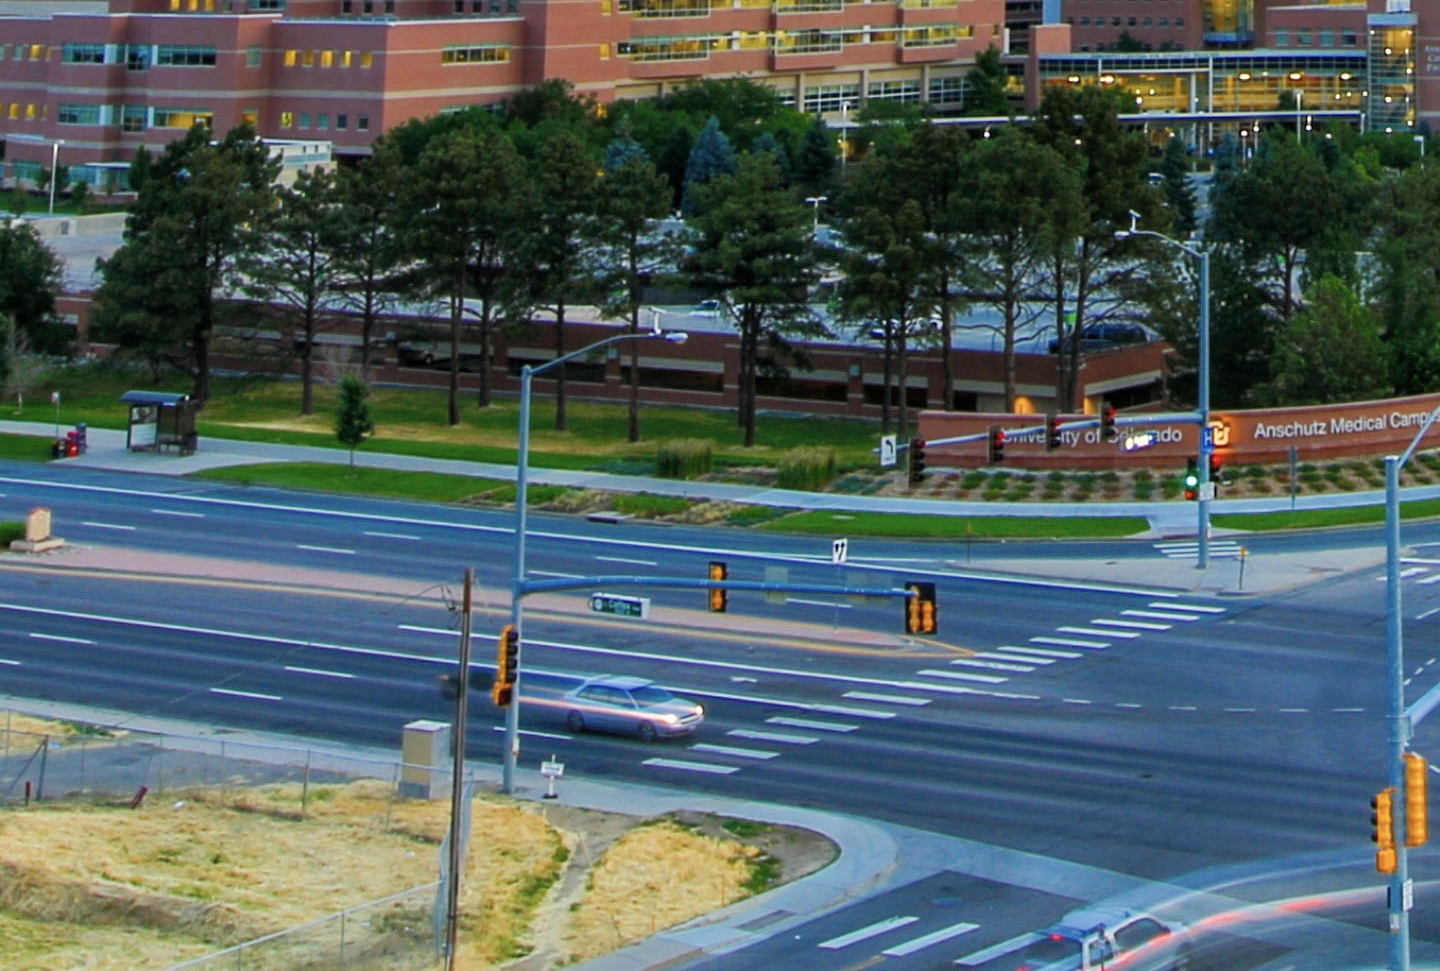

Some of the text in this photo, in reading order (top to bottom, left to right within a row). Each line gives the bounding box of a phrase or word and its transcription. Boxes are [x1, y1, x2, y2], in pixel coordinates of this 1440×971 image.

[1085, 426, 1101, 444] of
[1253, 421, 1327, 439] Anschutz
[1331, 414, 1387, 434] Medical
